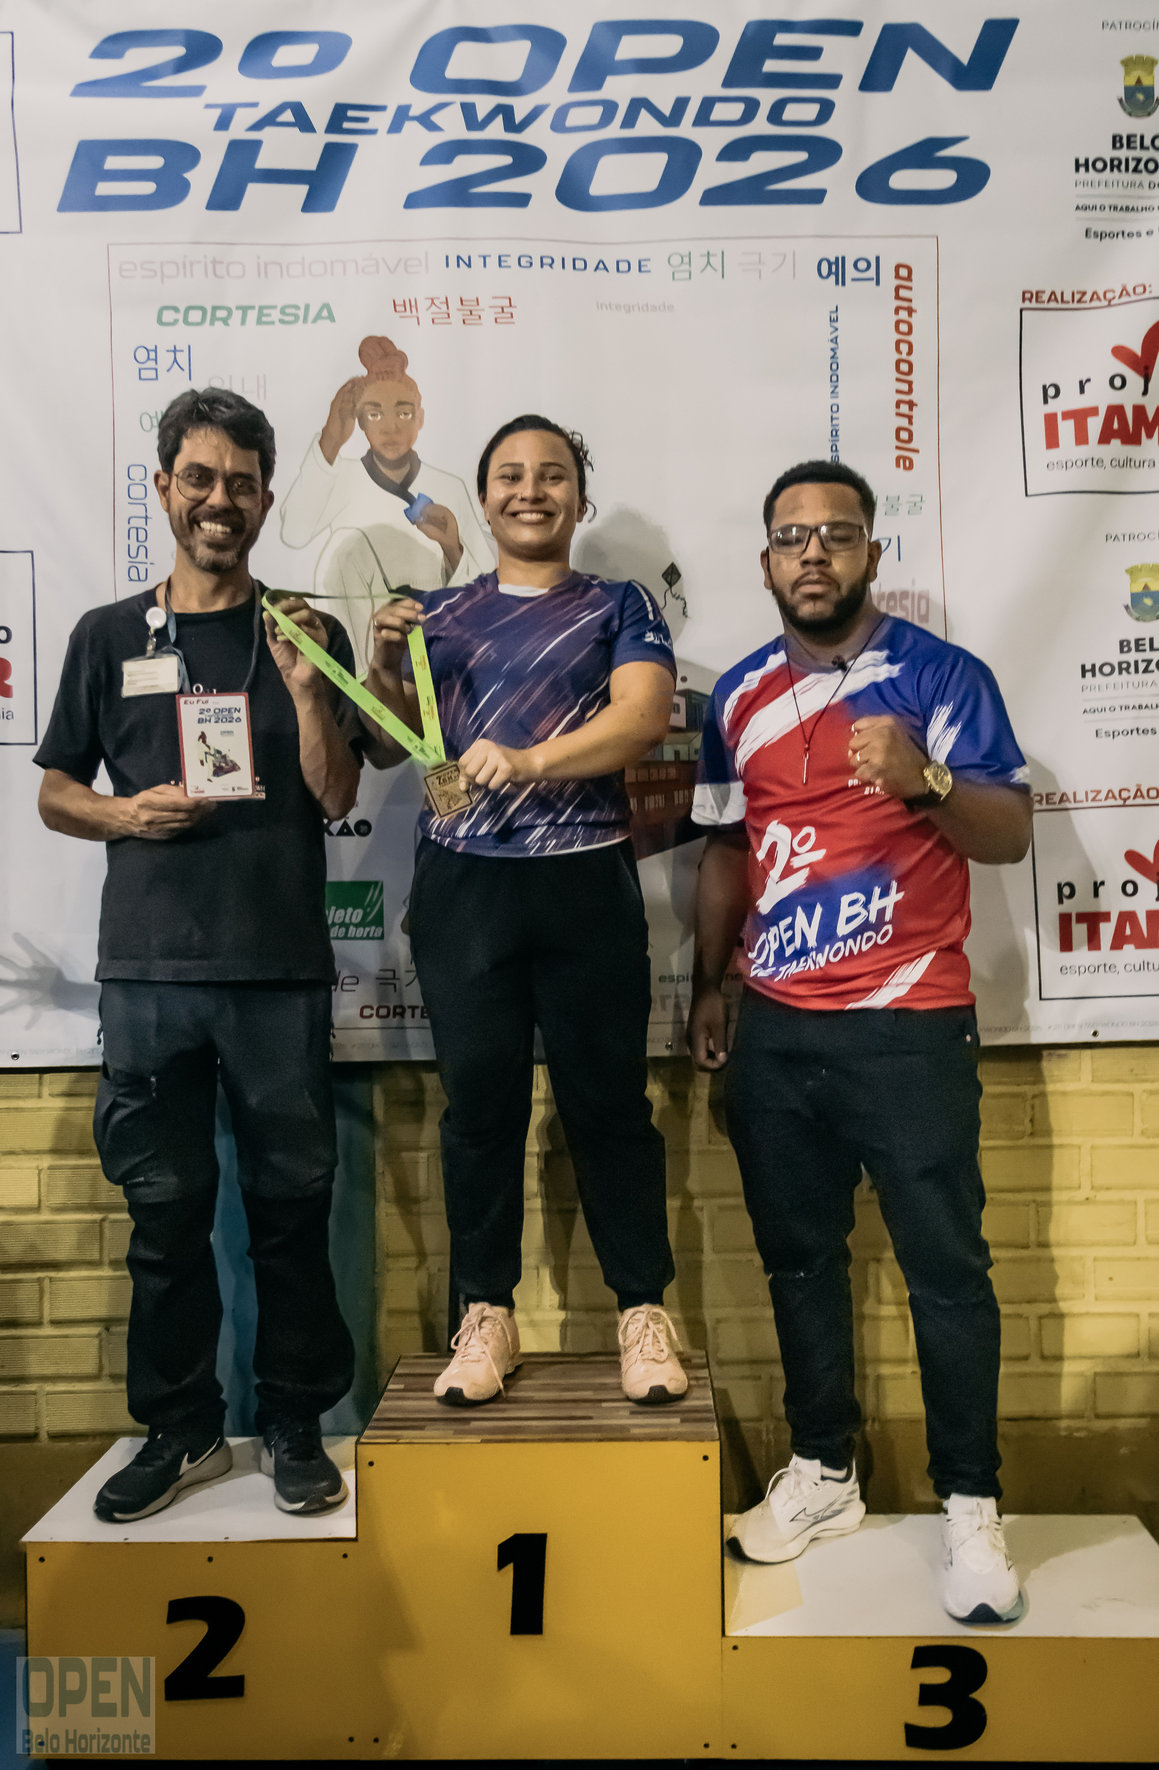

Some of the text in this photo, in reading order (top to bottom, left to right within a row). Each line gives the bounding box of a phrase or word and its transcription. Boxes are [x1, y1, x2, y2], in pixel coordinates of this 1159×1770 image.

[409, 17, 1020, 99] OPEN
[204, 96, 836, 136] TAEKWONDO
[57, 134, 992, 214] BH 2026
[1075, 179, 1145, 189] PREFEITURA
[1075, 203, 1097, 212] AQUI
[1108, 204, 1155, 213] TRABALHO
[1085, 227, 1142, 242] Esportes
[256, 250, 430, 280] indomável
[445, 253, 652, 274] INTEGRIDADE
[668, 249, 726, 281] 염치
[816, 254, 881, 288] 예의
[156, 302, 337, 327] CORTESIA
[392, 295, 518, 327] 백절불굴
[595, 300, 675, 315] integridade
[133, 344, 193, 382] 염치
[893, 263, 920, 472] autocontrole
[829, 305, 840, 464] SPÍRITO INDOMÁVEL
[1110, 454, 1156, 469] cultura
[127, 464, 155, 583] cortesia
[1080, 658, 1159, 679] HORIZ
[1081, 679, 1158, 693] PREFEITURA
[213, 706, 241, 714] OPEN
[214, 716, 242, 724] 2026
[1083, 706, 1107, 715] AQUI
[1095, 726, 1157, 741] Esportes
[348, 924, 383, 938] horta
[748, 879, 906, 967] OPEN BH
[774, 923, 894, 982] TAEKWONDO
[497, 1532, 548, 1636] 1
[164, 1595, 246, 1702] 2
[903, 1643, 990, 1751] 3
